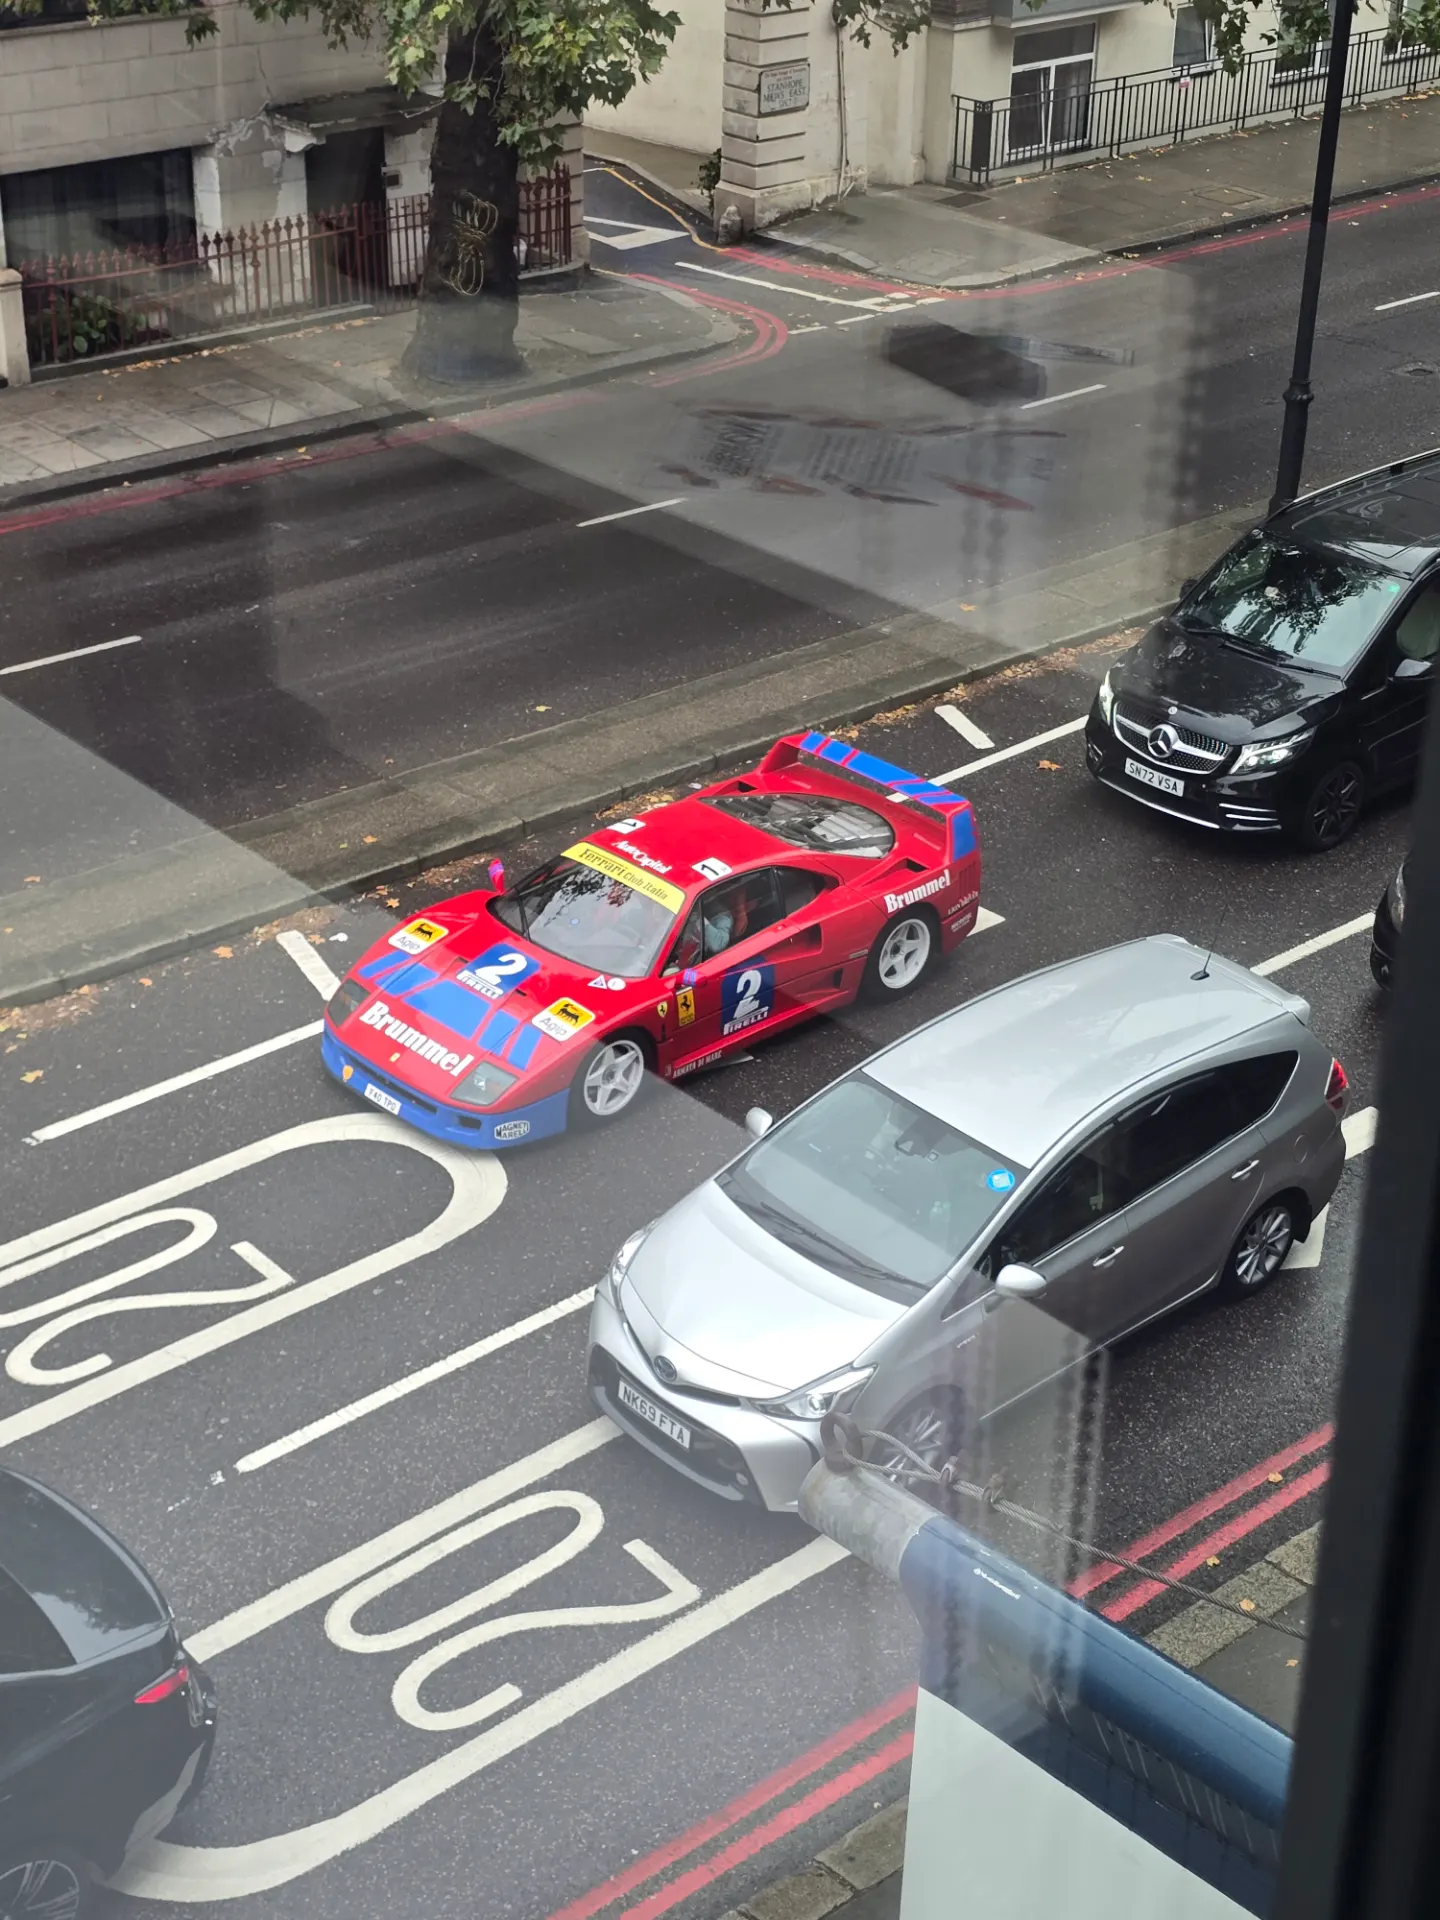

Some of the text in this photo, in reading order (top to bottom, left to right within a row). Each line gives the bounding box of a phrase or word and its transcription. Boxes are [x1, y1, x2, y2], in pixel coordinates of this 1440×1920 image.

[763, 87, 806, 103] MEWS EAST
[767, 79, 803, 93] STANHOPE
[1129, 762, 1178, 793] SN72 VSA
[578, 848, 668, 900] Ferrari Club Italia
[883, 868, 951, 914] Brummel
[396, 935, 421, 951] Agip
[455, 969, 504, 1000] PIRELLI
[474, 952, 528, 986] 2
[733, 969, 762, 1020] 2
[539, 1016, 568, 1037] Agip
[723, 1005, 769, 1036] PIRELLI
[358, 1000, 476, 1078] Brummel
[0, 1206, 297, 1387] 20
[623, 1386, 685, 1444] NK69 FTA
[324, 1489, 702, 1732] 20
